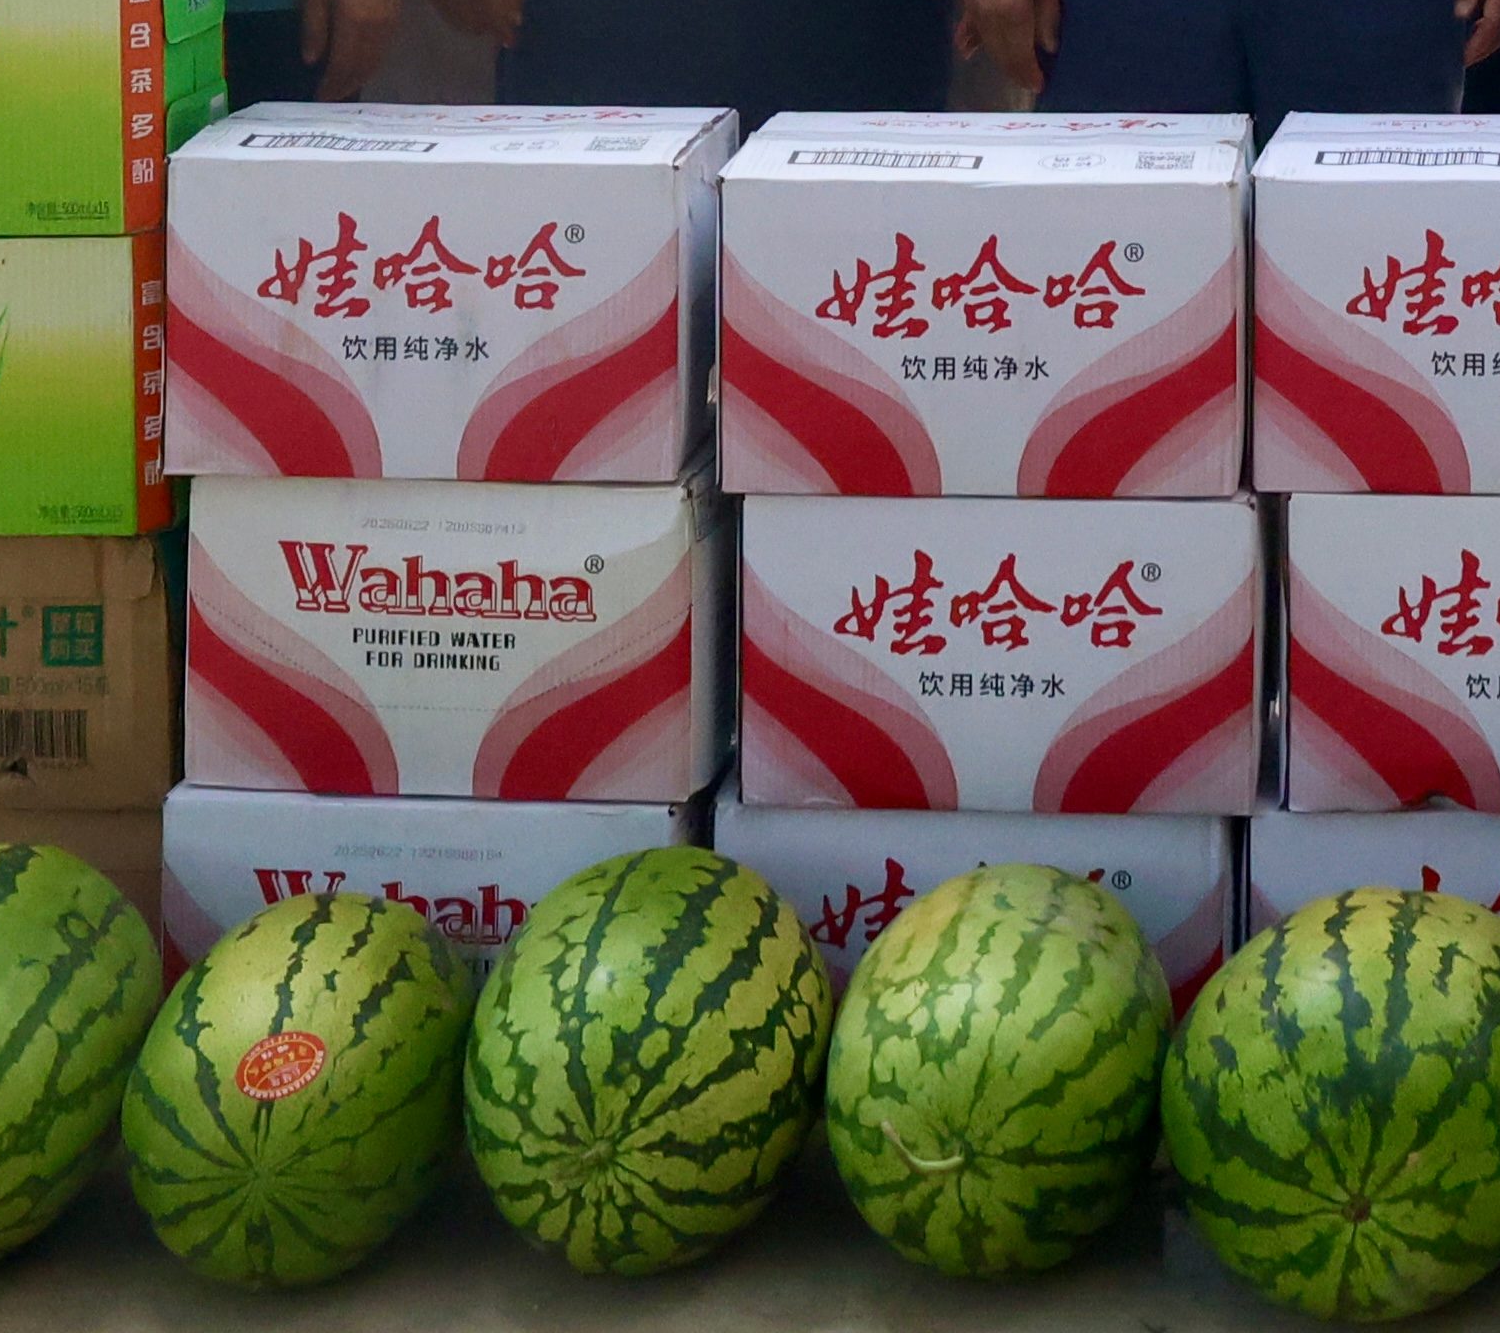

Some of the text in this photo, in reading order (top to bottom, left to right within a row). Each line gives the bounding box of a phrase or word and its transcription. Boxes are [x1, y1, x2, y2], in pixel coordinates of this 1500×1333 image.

[258, 211, 586, 319] 娃哈哈
[816, 233, 1145, 338] 娃哈哈
[342, 334, 490, 362] 饮用纯净水
[900, 354, 1050, 382] 饮用纯净水
[278, 540, 598, 624] Wahaha
[834, 549, 1163, 656] 娃哈哈
[352, 627, 517, 650] PURIFIED WATER
[366, 650, 501, 672] FOR DRINKING
[918, 669, 1066, 698] 饮用纯净水
